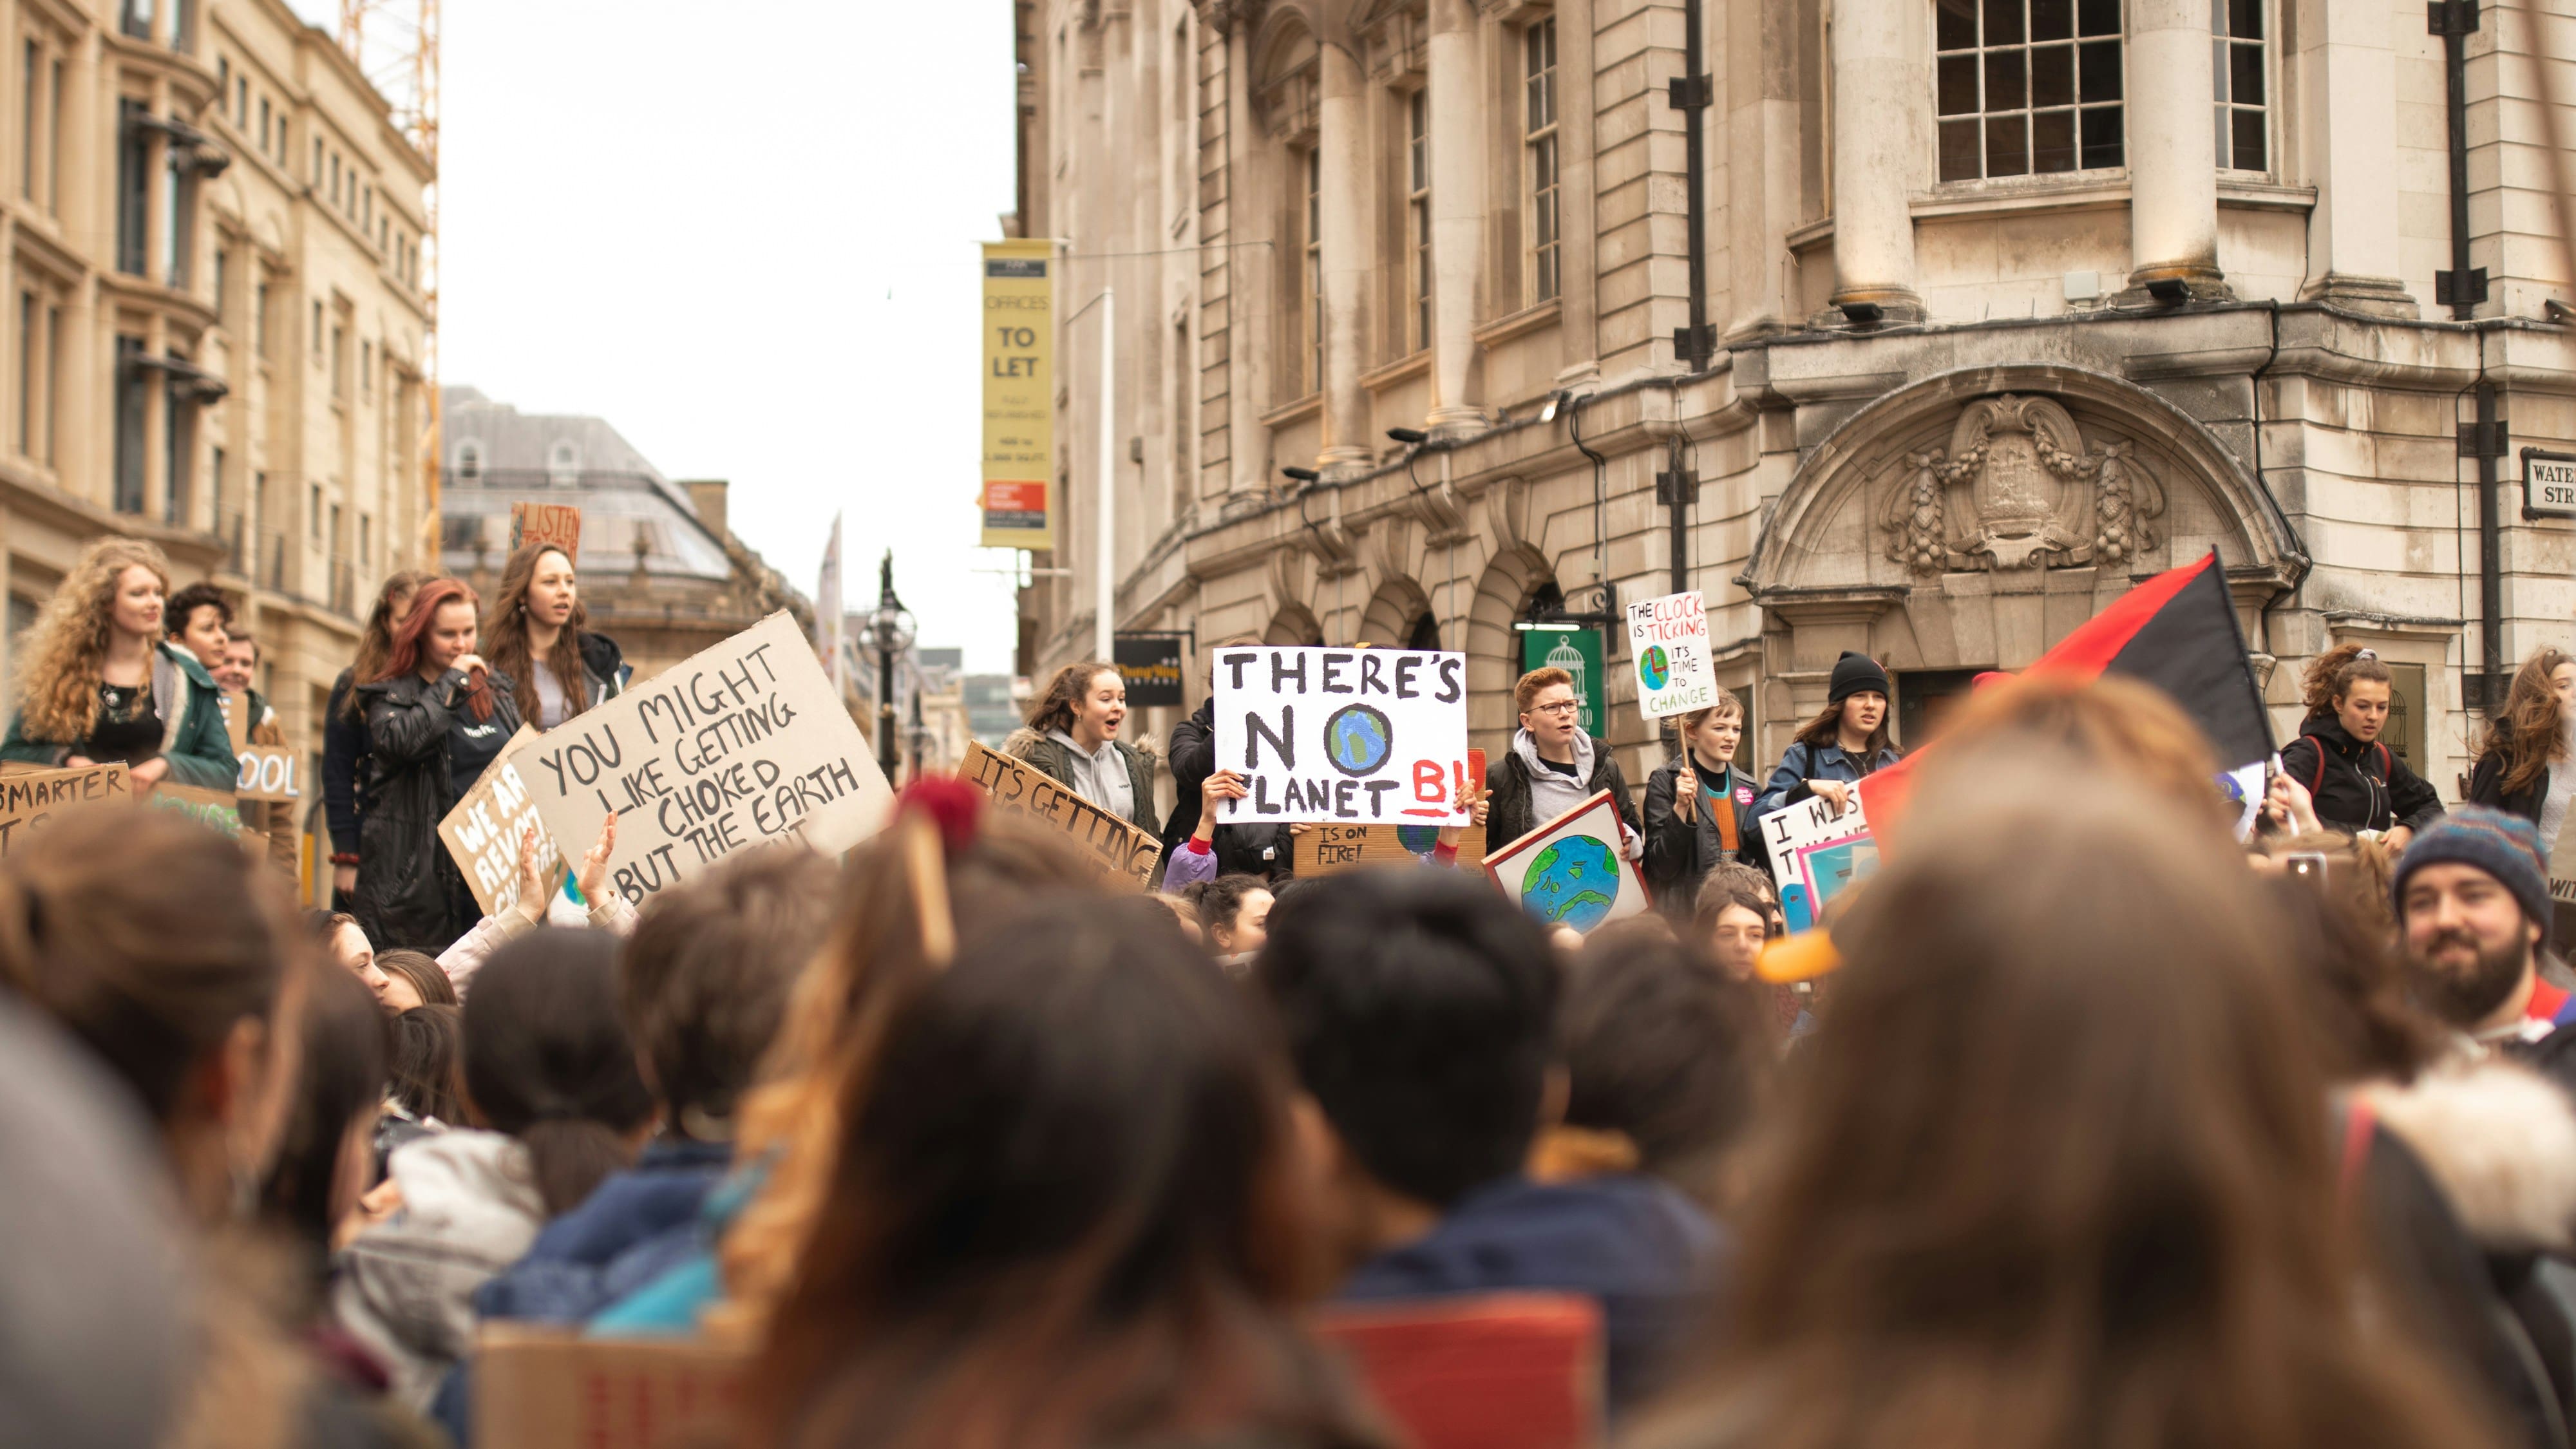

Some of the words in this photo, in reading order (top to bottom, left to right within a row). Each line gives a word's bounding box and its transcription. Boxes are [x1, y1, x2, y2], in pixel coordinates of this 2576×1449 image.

[985, 295, 1049, 310] OFFICES
[998, 327, 1036, 347] TO
[993, 357, 1039, 377] LET
[2533, 464, 2576, 484] WATE
[522, 503, 580, 538] LISTEN
[1629, 602, 1653, 621] THE
[1654, 594, 1705, 622] CLOCK
[1634, 625, 1644, 638] IS
[1647, 618, 1706, 642] TICKING
[1671, 645, 1690, 659] IT'S
[1671, 658, 1698, 673] TIME
[1223, 651, 1462, 704] THERE'S
[1673, 677, 1687, 687] TO
[1649, 687, 1709, 713] CHANGE
[539, 723, 621, 797] YOU
[637, 643, 777, 744] MIGHT
[596, 757, 674, 817] LIKE
[674, 692, 797, 775] GETTING
[1245, 702, 1393, 779] NO
[658, 759, 781, 837] CHOKED
[1412, 759, 1466, 815] B!
[454, 800, 498, 853] WE
[491, 762, 528, 819] AR
[972, 749, 1025, 801] IT'S
[1030, 782, 1158, 882] GETTING
[1771, 815, 1792, 844] I
[1808, 789, 1859, 828] WIS
[612, 843, 682, 907] BUT
[684, 811, 748, 864] THE
[752, 757, 860, 835] EARTH
[1320, 827, 1340, 844] IS
[1345, 826, 1367, 839] ON
[1318, 844, 1363, 865] FIRE!
